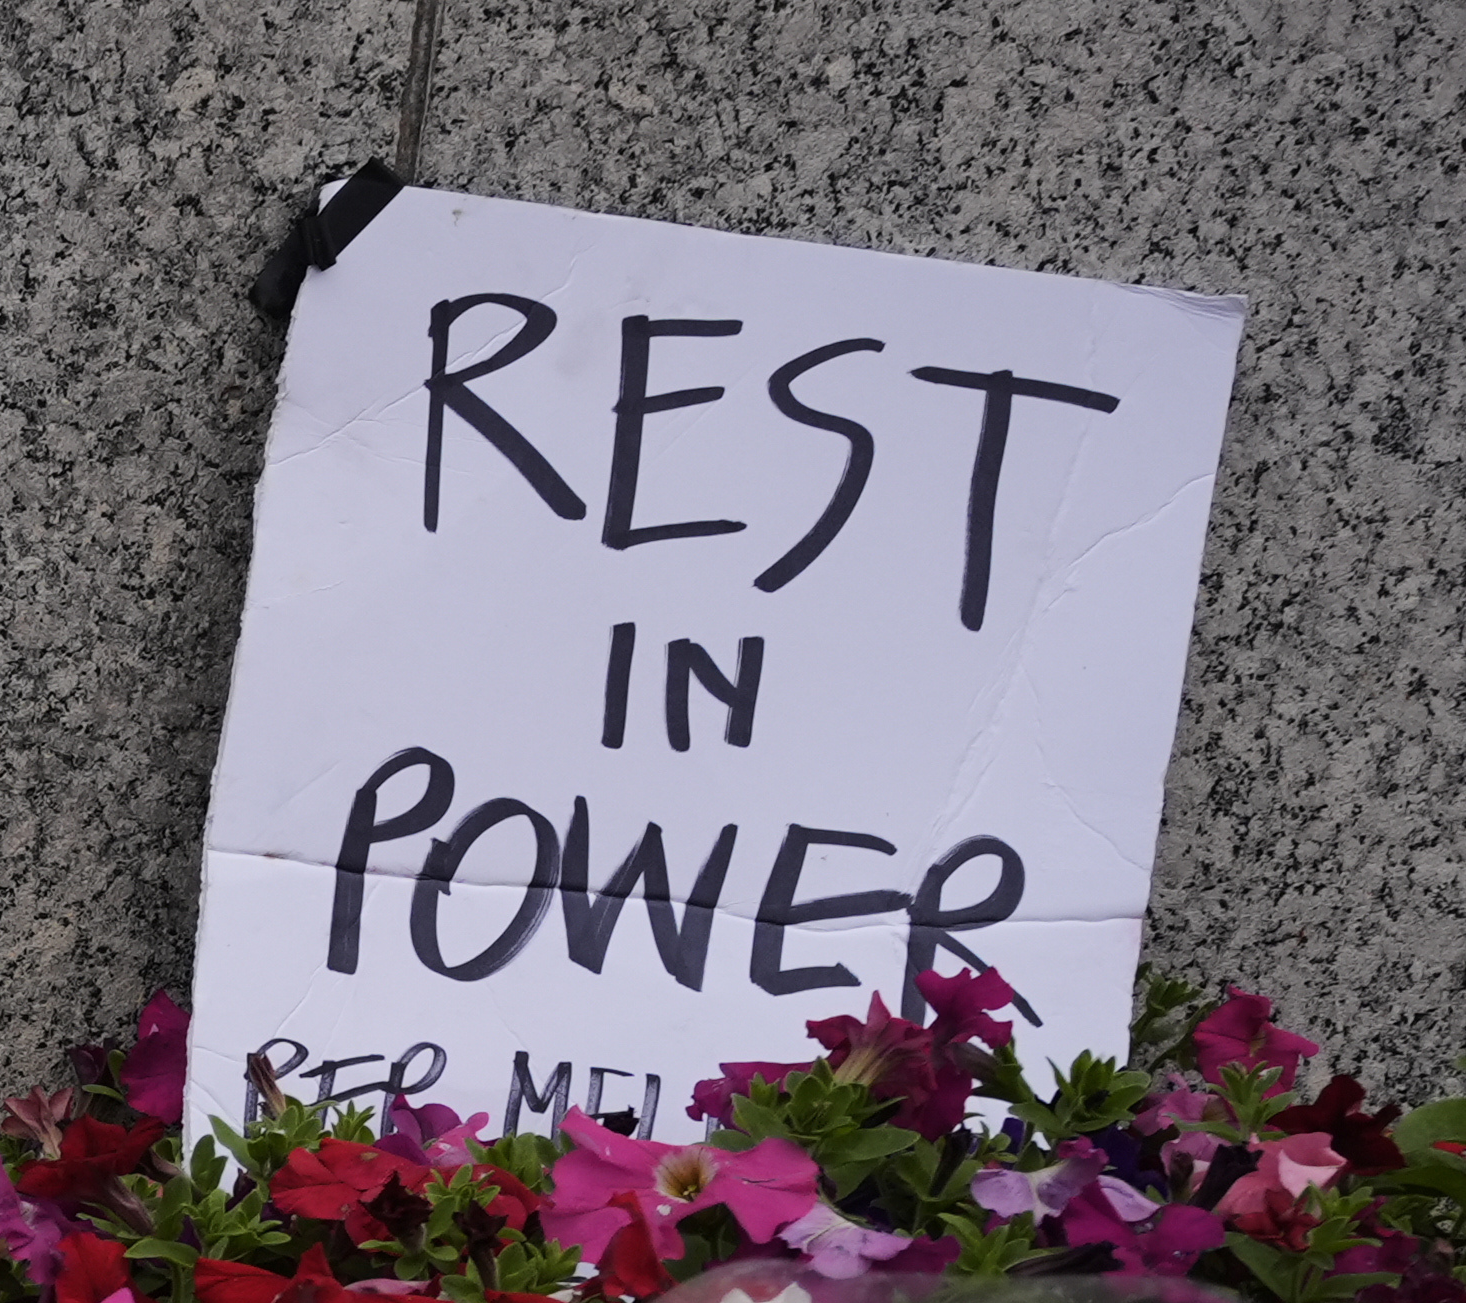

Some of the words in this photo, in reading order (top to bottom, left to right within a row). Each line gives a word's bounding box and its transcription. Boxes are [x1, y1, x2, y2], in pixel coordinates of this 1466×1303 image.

[425, 291, 1119, 632] REST
[602, 621, 764, 750] IN
[326, 746, 1043, 1027] POWER
